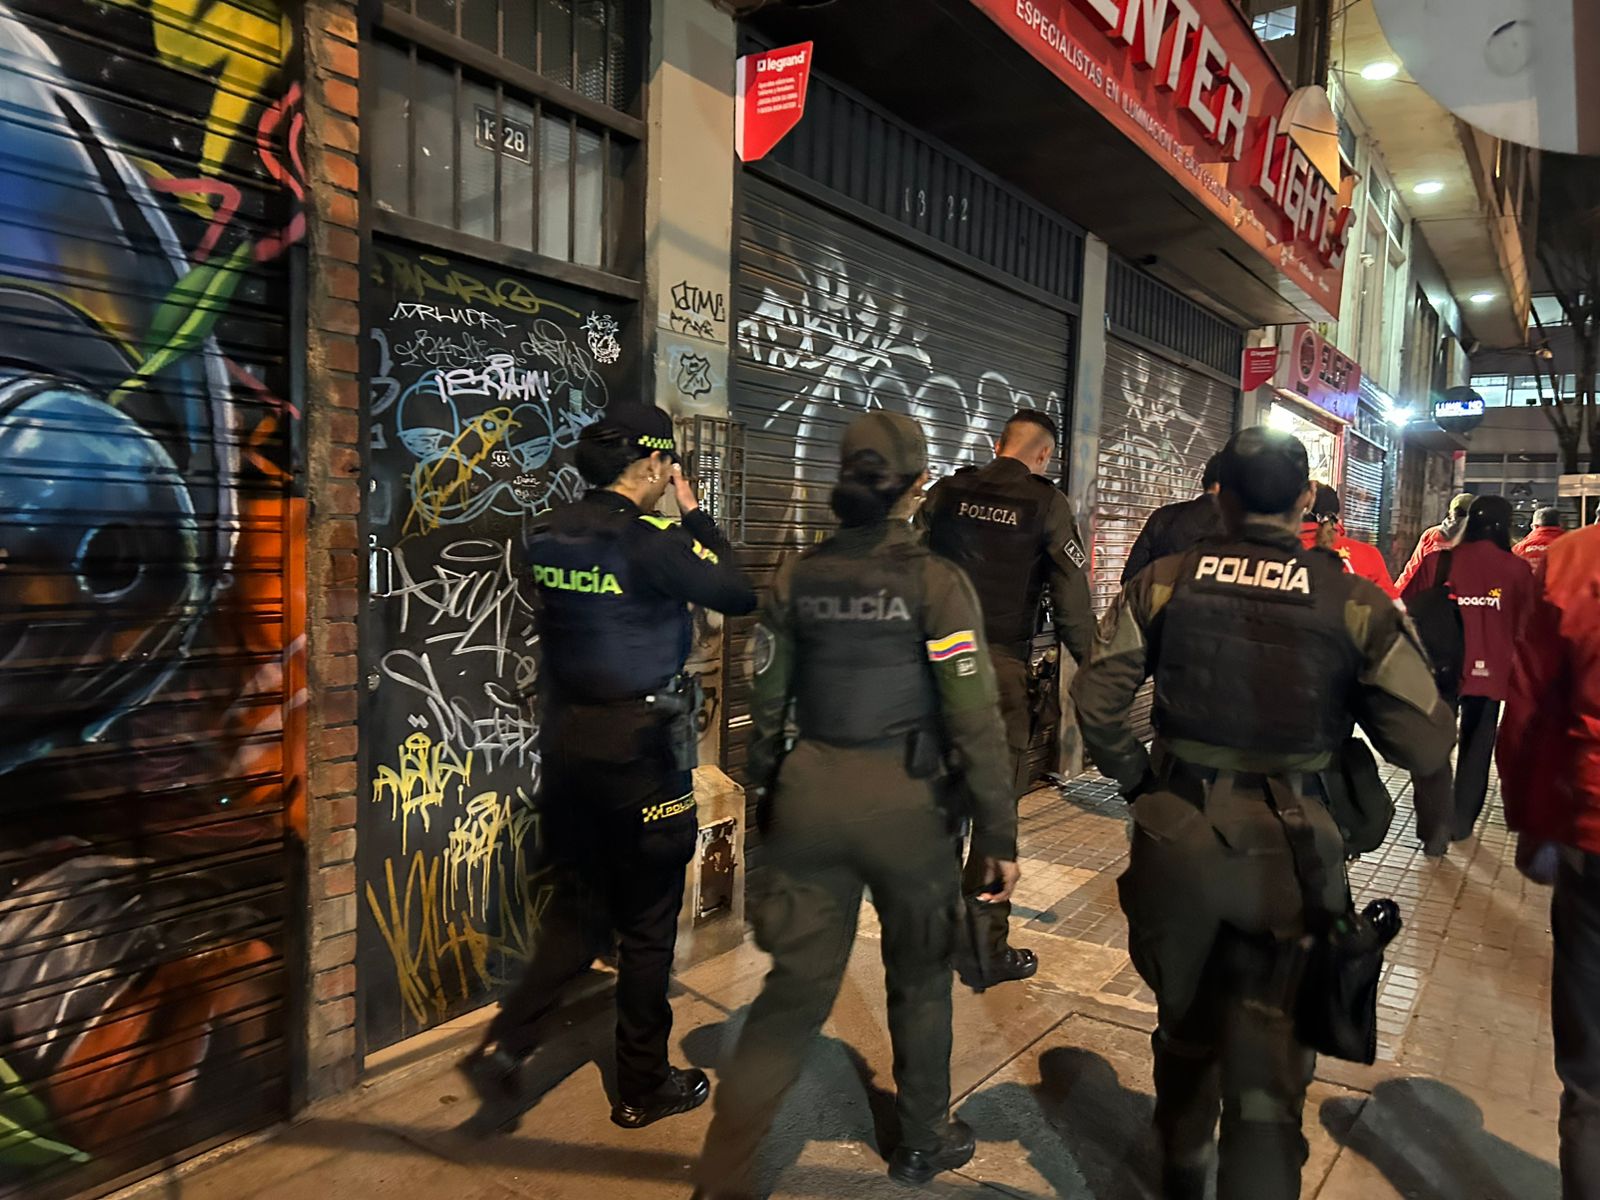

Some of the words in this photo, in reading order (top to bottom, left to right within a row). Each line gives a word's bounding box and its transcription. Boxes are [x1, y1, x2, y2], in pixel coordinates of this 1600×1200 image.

[767, 51, 806, 72] legrand
[1015, 0, 1104, 89] ESPECIALISTAS
[1105, 76, 1120, 104] EN
[958, 502, 1019, 526] POLICIA
[532, 564, 624, 595] POLICÍA
[1194, 556, 1310, 594] POLICÍA
